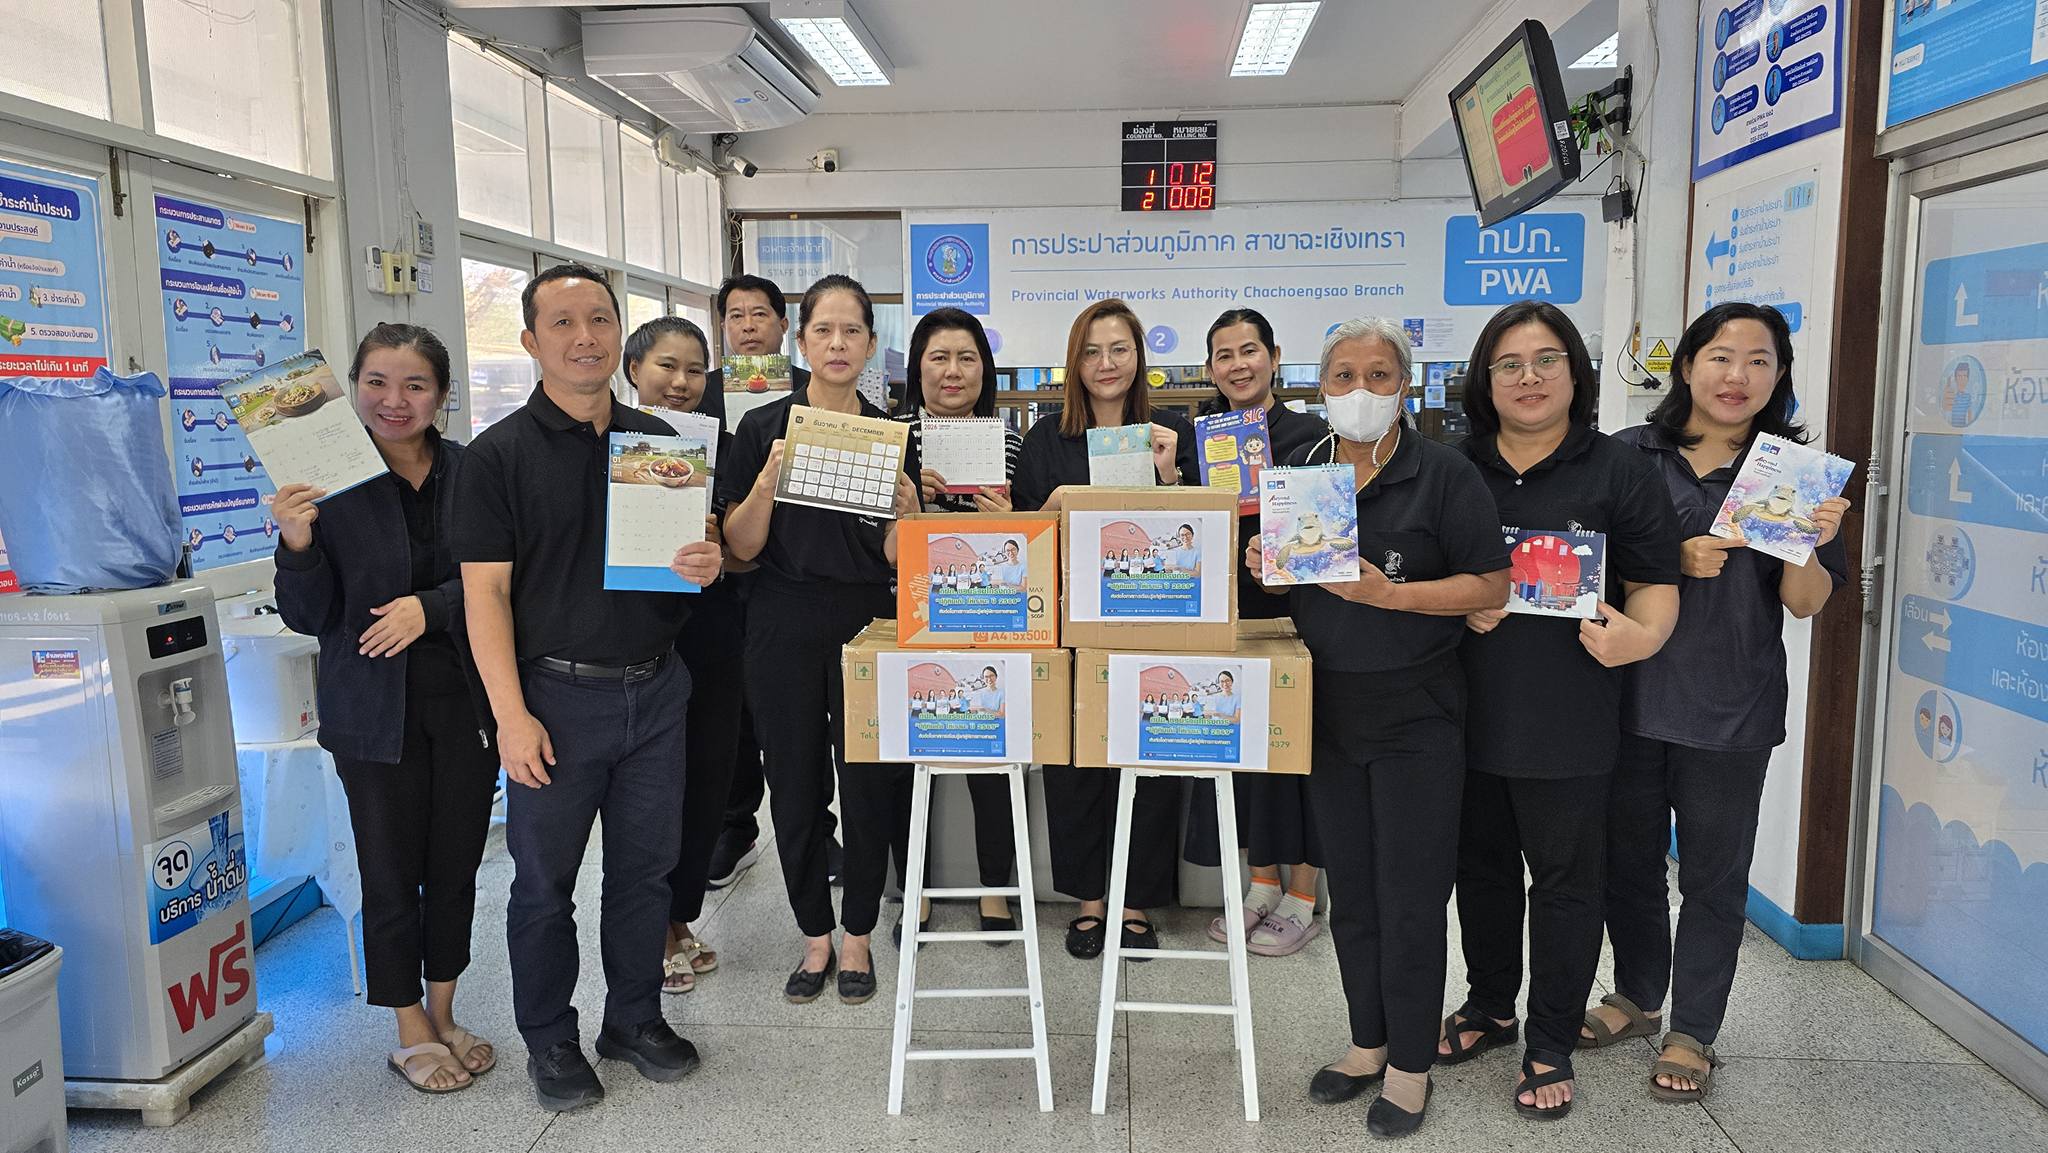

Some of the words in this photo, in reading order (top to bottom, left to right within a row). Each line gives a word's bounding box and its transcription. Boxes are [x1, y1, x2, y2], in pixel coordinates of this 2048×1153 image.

[1133, 123, 1155, 134] ช่องที่
[1149, 169, 1155, 185] 1
[1169, 162, 1213, 185] 012
[1143, 192, 1155, 209] 2
[1169, 187, 1213, 208] 008
[1011, 230, 1235, 260] การประปาส่วนภูมิภาค
[1244, 227, 1405, 251] สาขาฉะเชิงเทรา
[1478, 222, 1561, 255] กปภ.
[768, 269, 795, 277] STAFF
[798, 269, 820, 277] ONLY
[1480, 267, 1552, 296] PWA
[1012, 290, 1079, 302] Provincial
[1084, 287, 1166, 301] Waterworks
[1171, 286, 1239, 301] Authority
[1243, 285, 1349, 300] Chachoengsao
[1354, 284, 1405, 297] Branch
[1153, 332, 1166, 347] 2
[65, 361, 70, 370] 1
[73, 360, 89, 372] นาที
[851, 426, 885, 437] DECEMBER
[1905, 598, 1930, 622] เลื่อน
[990, 631, 1008, 641] A4
[157, 849, 189, 887] จุด
[160, 892, 203, 925] บริการ
[206, 850, 246, 901] น้ำดื่ม
[168, 919, 250, 1034] ฟรี
